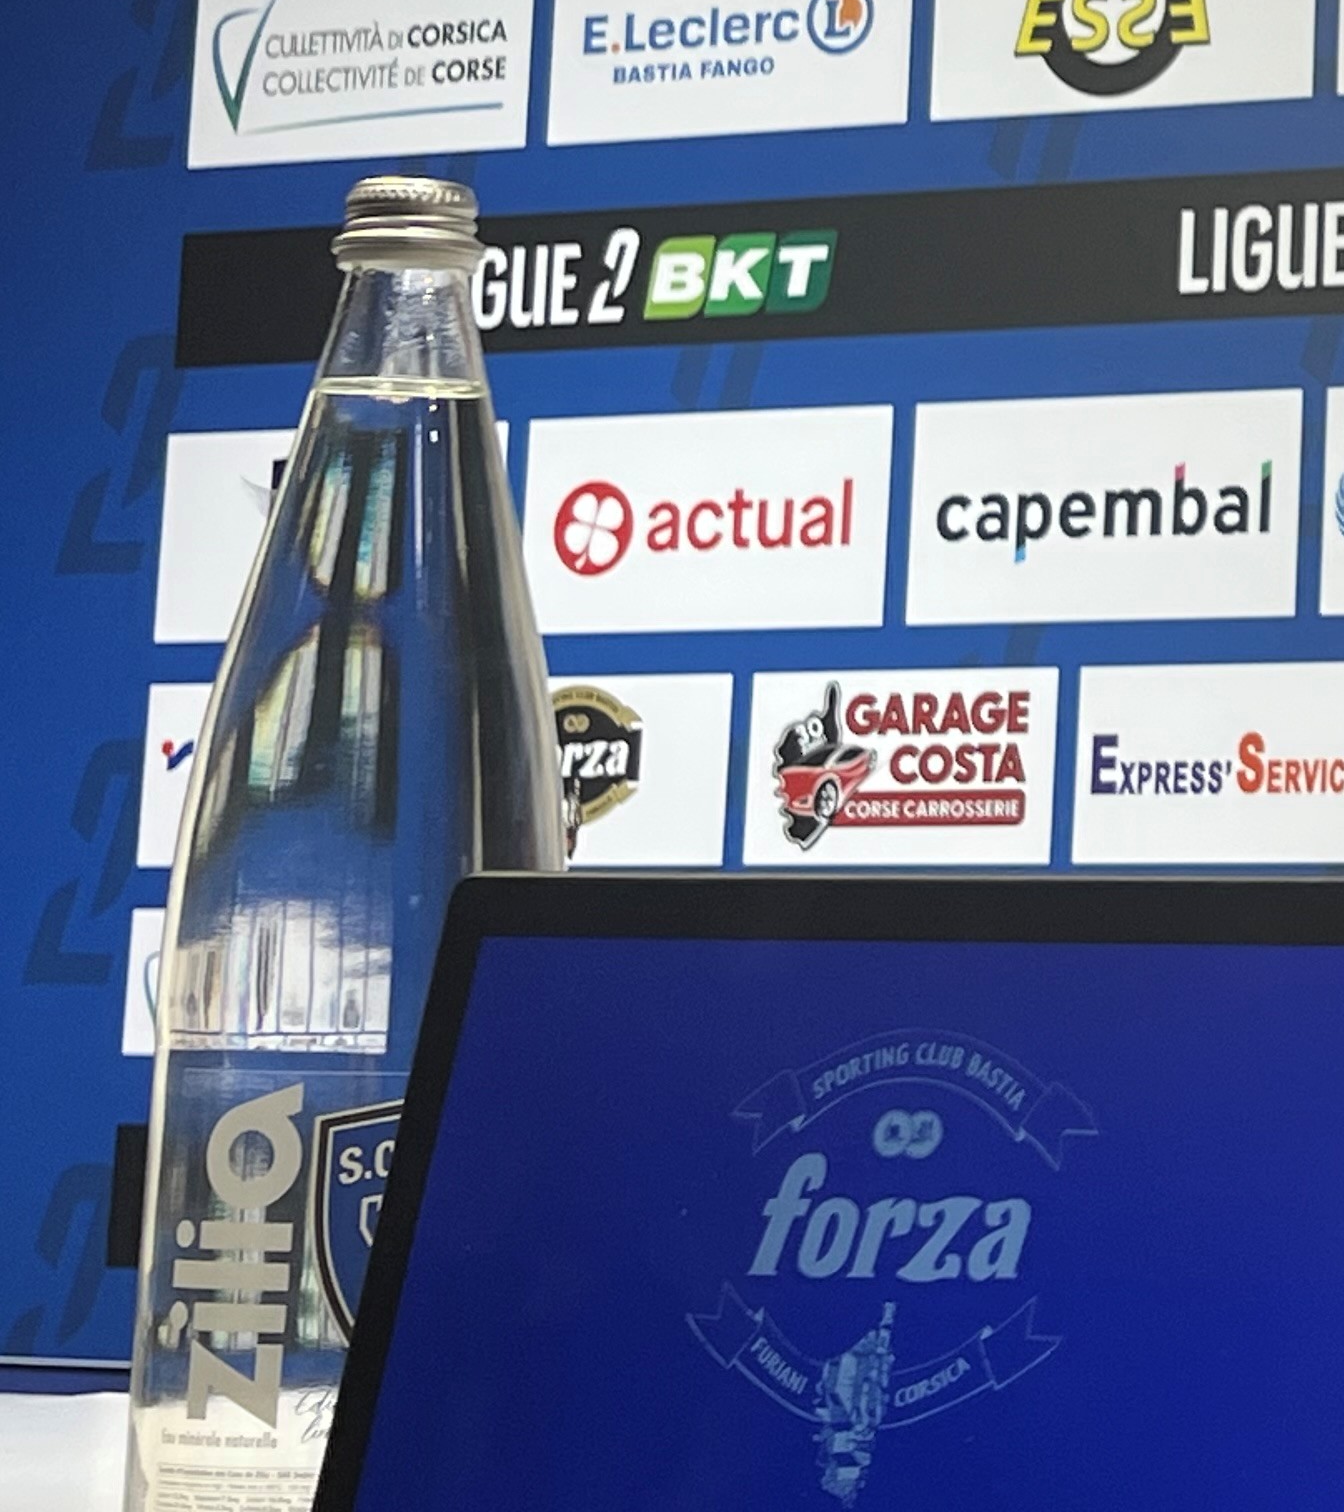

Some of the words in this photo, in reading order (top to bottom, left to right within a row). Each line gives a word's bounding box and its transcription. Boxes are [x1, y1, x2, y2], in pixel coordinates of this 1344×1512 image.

[388, 31, 404, 47] DI
[407, 19, 508, 47] CORSICA
[583, 5, 800, 55] E.Leclerc
[263, 61, 400, 97] COLLECTIVITÉ
[404, 67, 425, 86] DE
[431, 55, 507, 83] CORSE
[613, 60, 693, 84] BASTIA
[700, 57, 775, 79] FANGO
[471, 243, 583, 330] GUE
[588, 228, 640, 323] 2
[651, 243, 830, 302] BKT
[646, 478, 854, 553] actual
[936, 460, 1273, 563] capembal
[845, 691, 1030, 736] GARAGE
[556, 738, 630, 778] rza
[889, 743, 1027, 784] COSTA
[843, 799, 901, 819] CORSE
[903, 797, 1020, 819] CARROSSERIE
[811, 1042, 910, 1100] SPORTING
[915, 1041, 965, 1070] CLUB
[966, 1053, 1027, 1112] BASTIA
[747, 1152, 1032, 1283] forza
[750, 1335, 808, 1395] FURIANI
[893, 1356, 971, 1408] CORSICA
